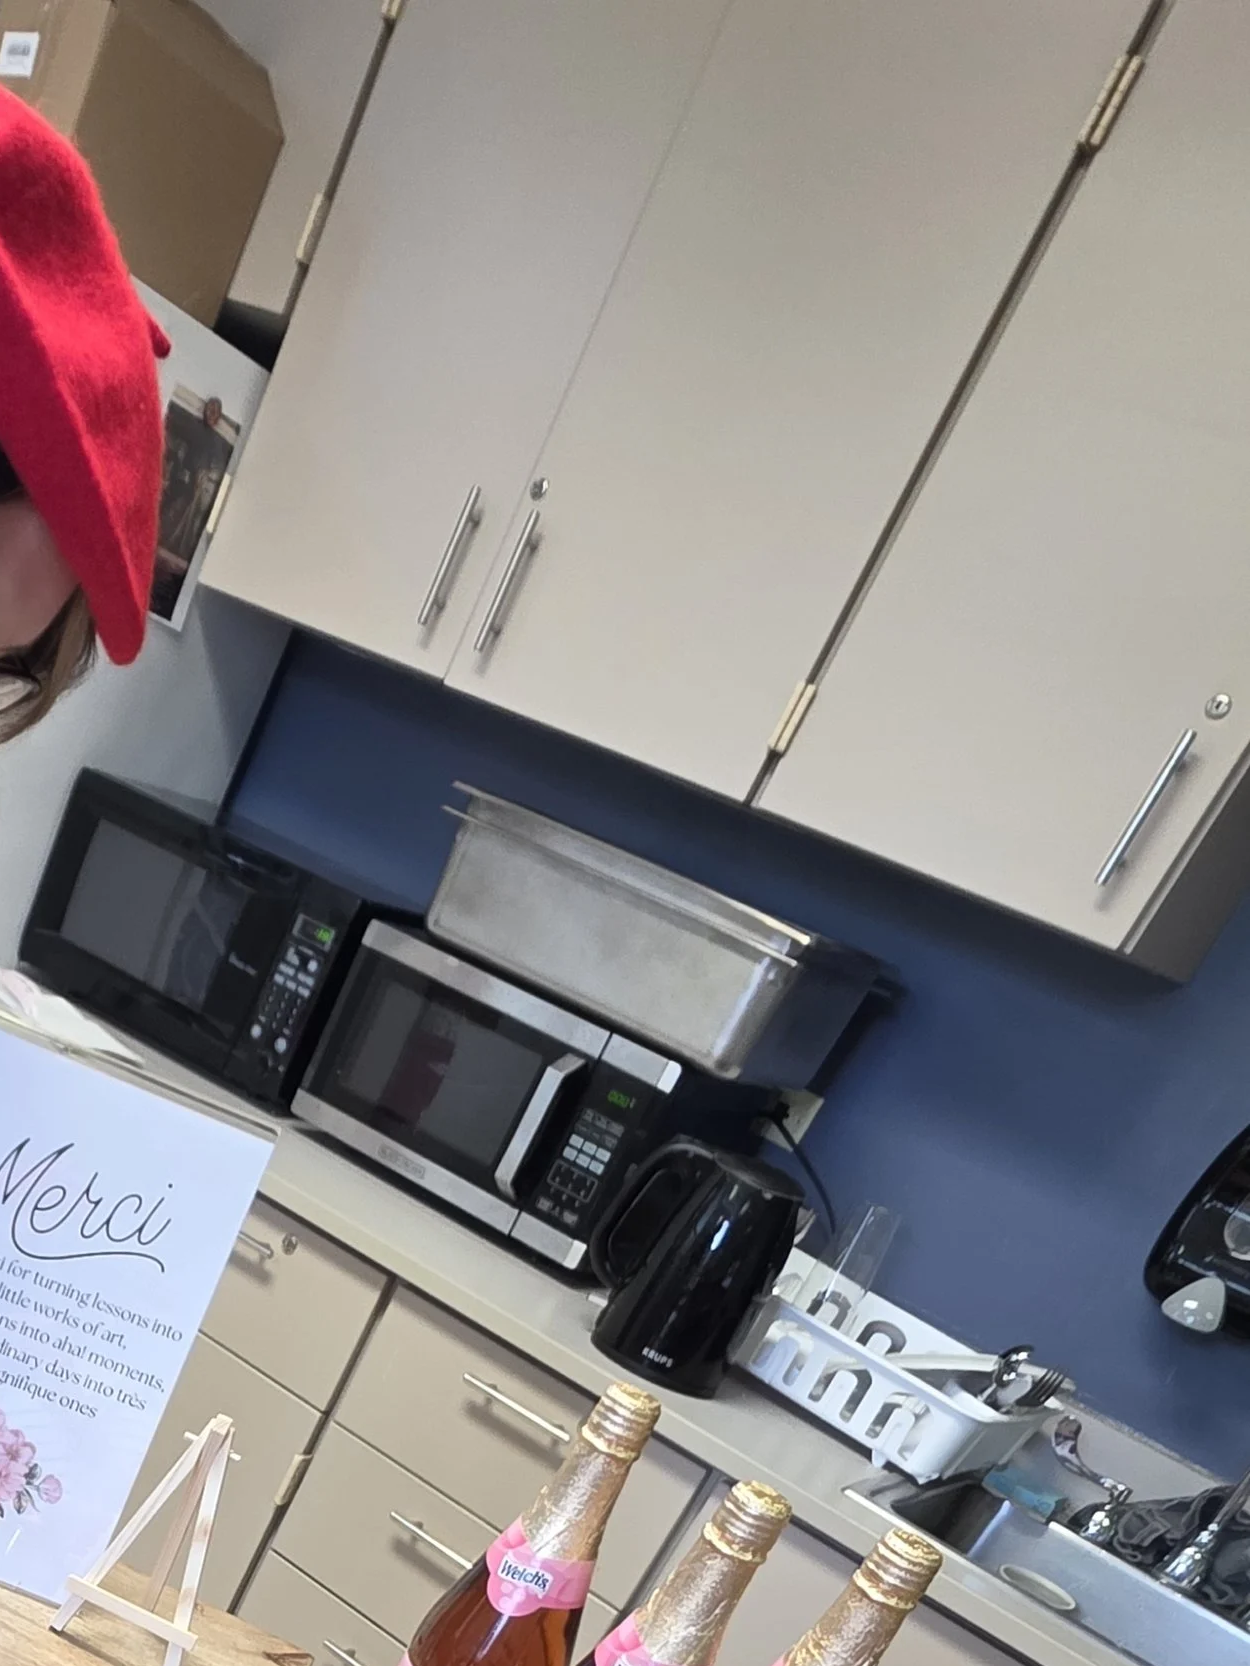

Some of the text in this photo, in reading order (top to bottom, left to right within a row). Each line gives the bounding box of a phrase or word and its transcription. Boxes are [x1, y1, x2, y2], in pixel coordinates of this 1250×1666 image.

[7, 1259, 31, 1280] for
[33, 1271, 92, 1309] turning
[92, 1291, 150, 1330] lessons
[151, 1317, 183, 1342] into
[33, 1300, 80, 1329] works
[82, 1319, 104, 1336] of
[100, 1330, 127, 1350] art,
[18, 1319, 51, 1344] into
[52, 1335, 88, 1359] aha!
[87, 1351, 166, 1393] moments,
[45, 1359, 82, 1385] days
[83, 1373, 114, 1398] into
[117, 1389, 147, 1411] très
[59, 1395, 99, 1418] ones
[501, 1559, 549, 1591] Welch's
